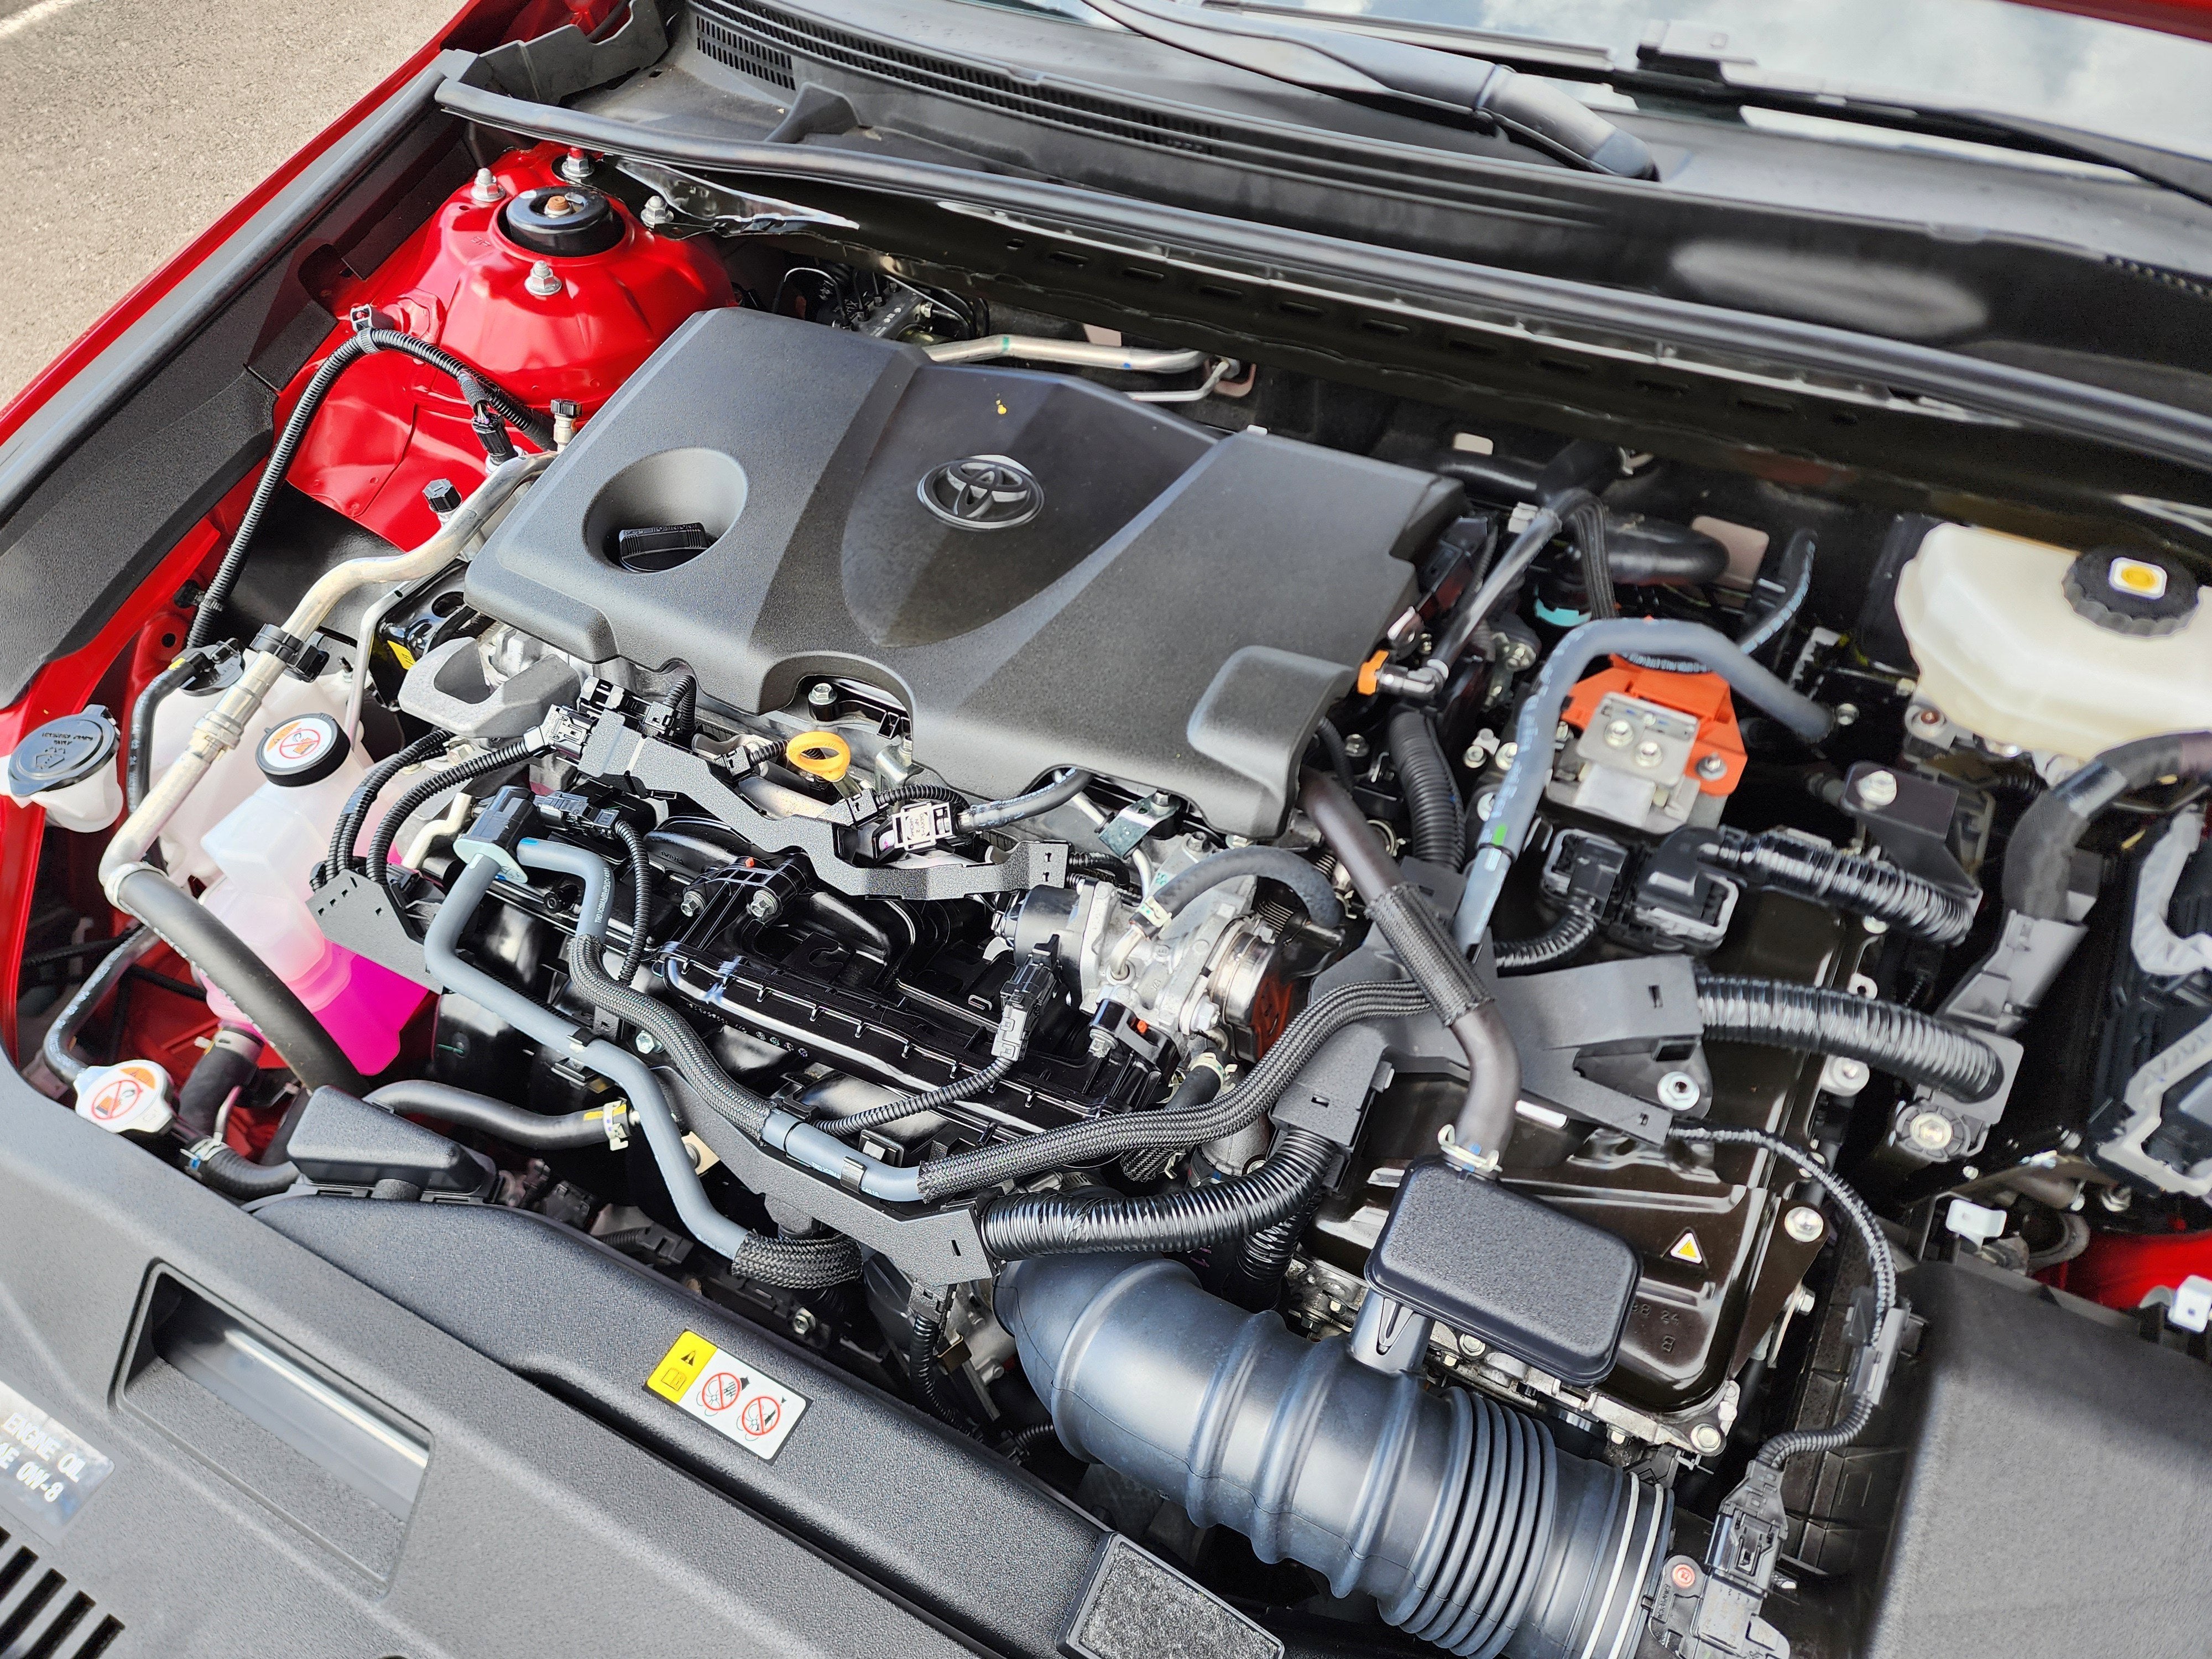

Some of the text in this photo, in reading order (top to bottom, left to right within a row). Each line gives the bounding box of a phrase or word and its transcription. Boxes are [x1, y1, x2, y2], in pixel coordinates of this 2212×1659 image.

[2, 1412, 86, 1483] ENGINE OIL
[17, 1462, 64, 1502] 0W-8
